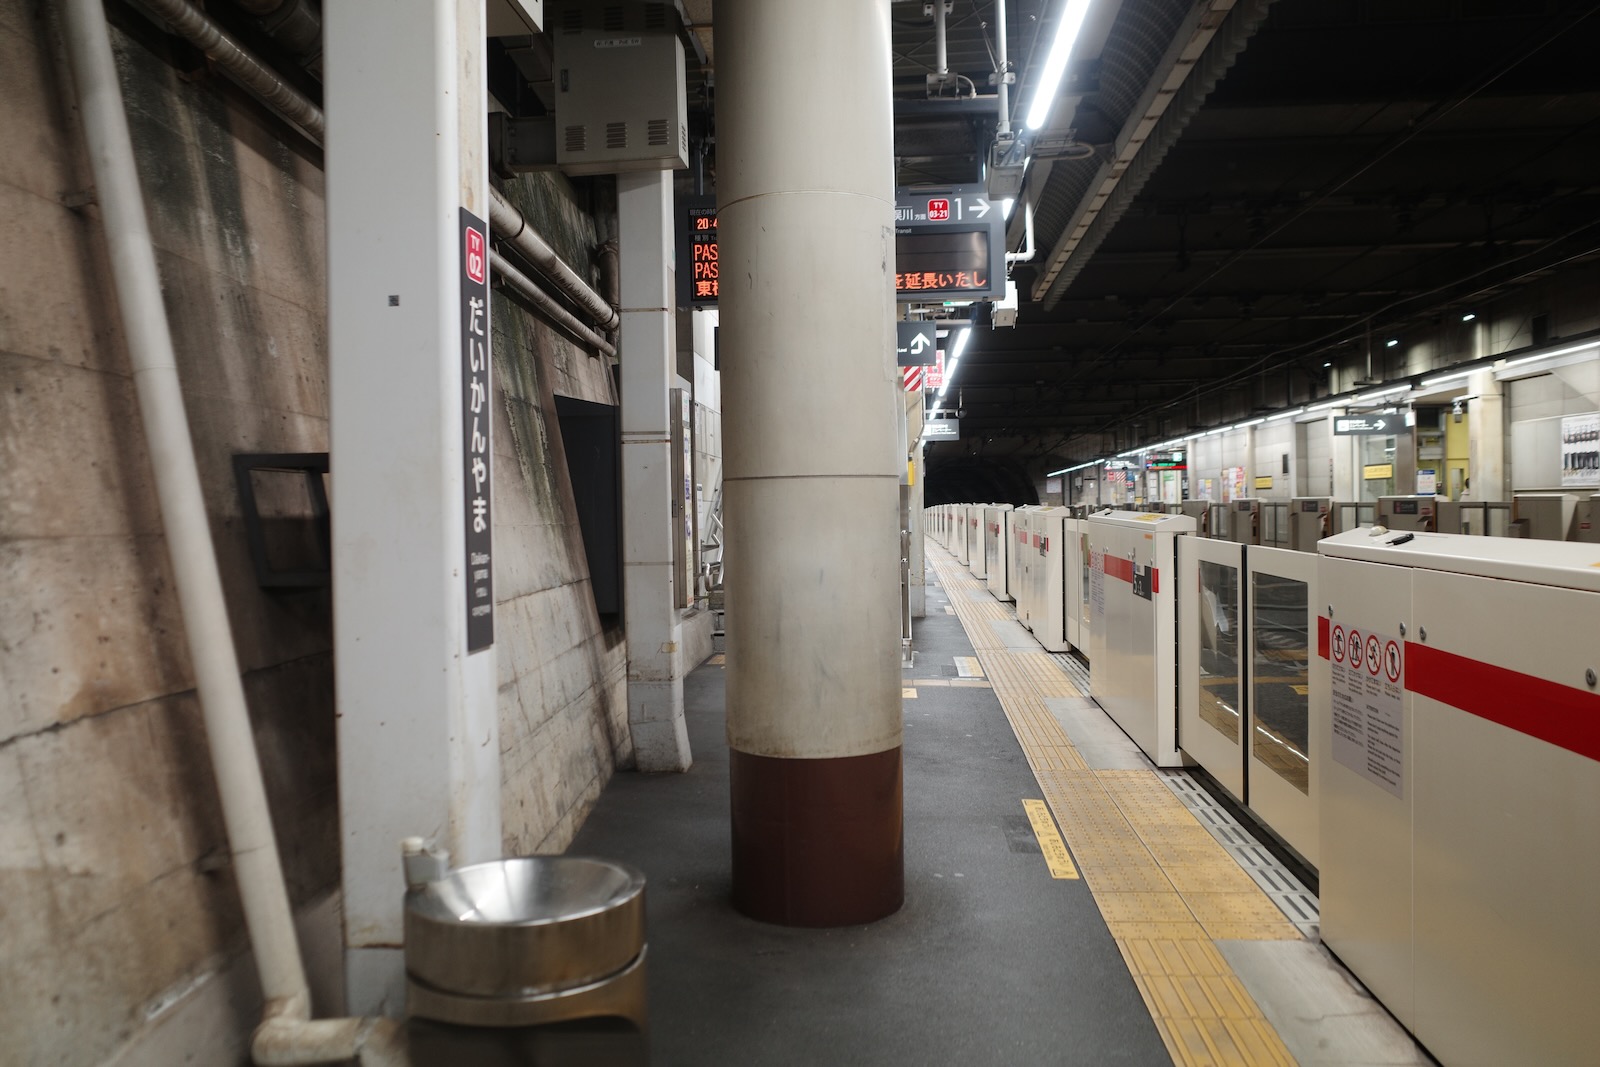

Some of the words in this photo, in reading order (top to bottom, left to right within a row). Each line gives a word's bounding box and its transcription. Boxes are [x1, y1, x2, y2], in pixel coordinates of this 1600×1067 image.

[929, 210, 948, 218] 03-21
[954, 198, 962, 220] 1
[470, 233, 481, 252] TY
[469, 252, 482, 278] 02
[469, 296, 486, 533] だいかんやま
